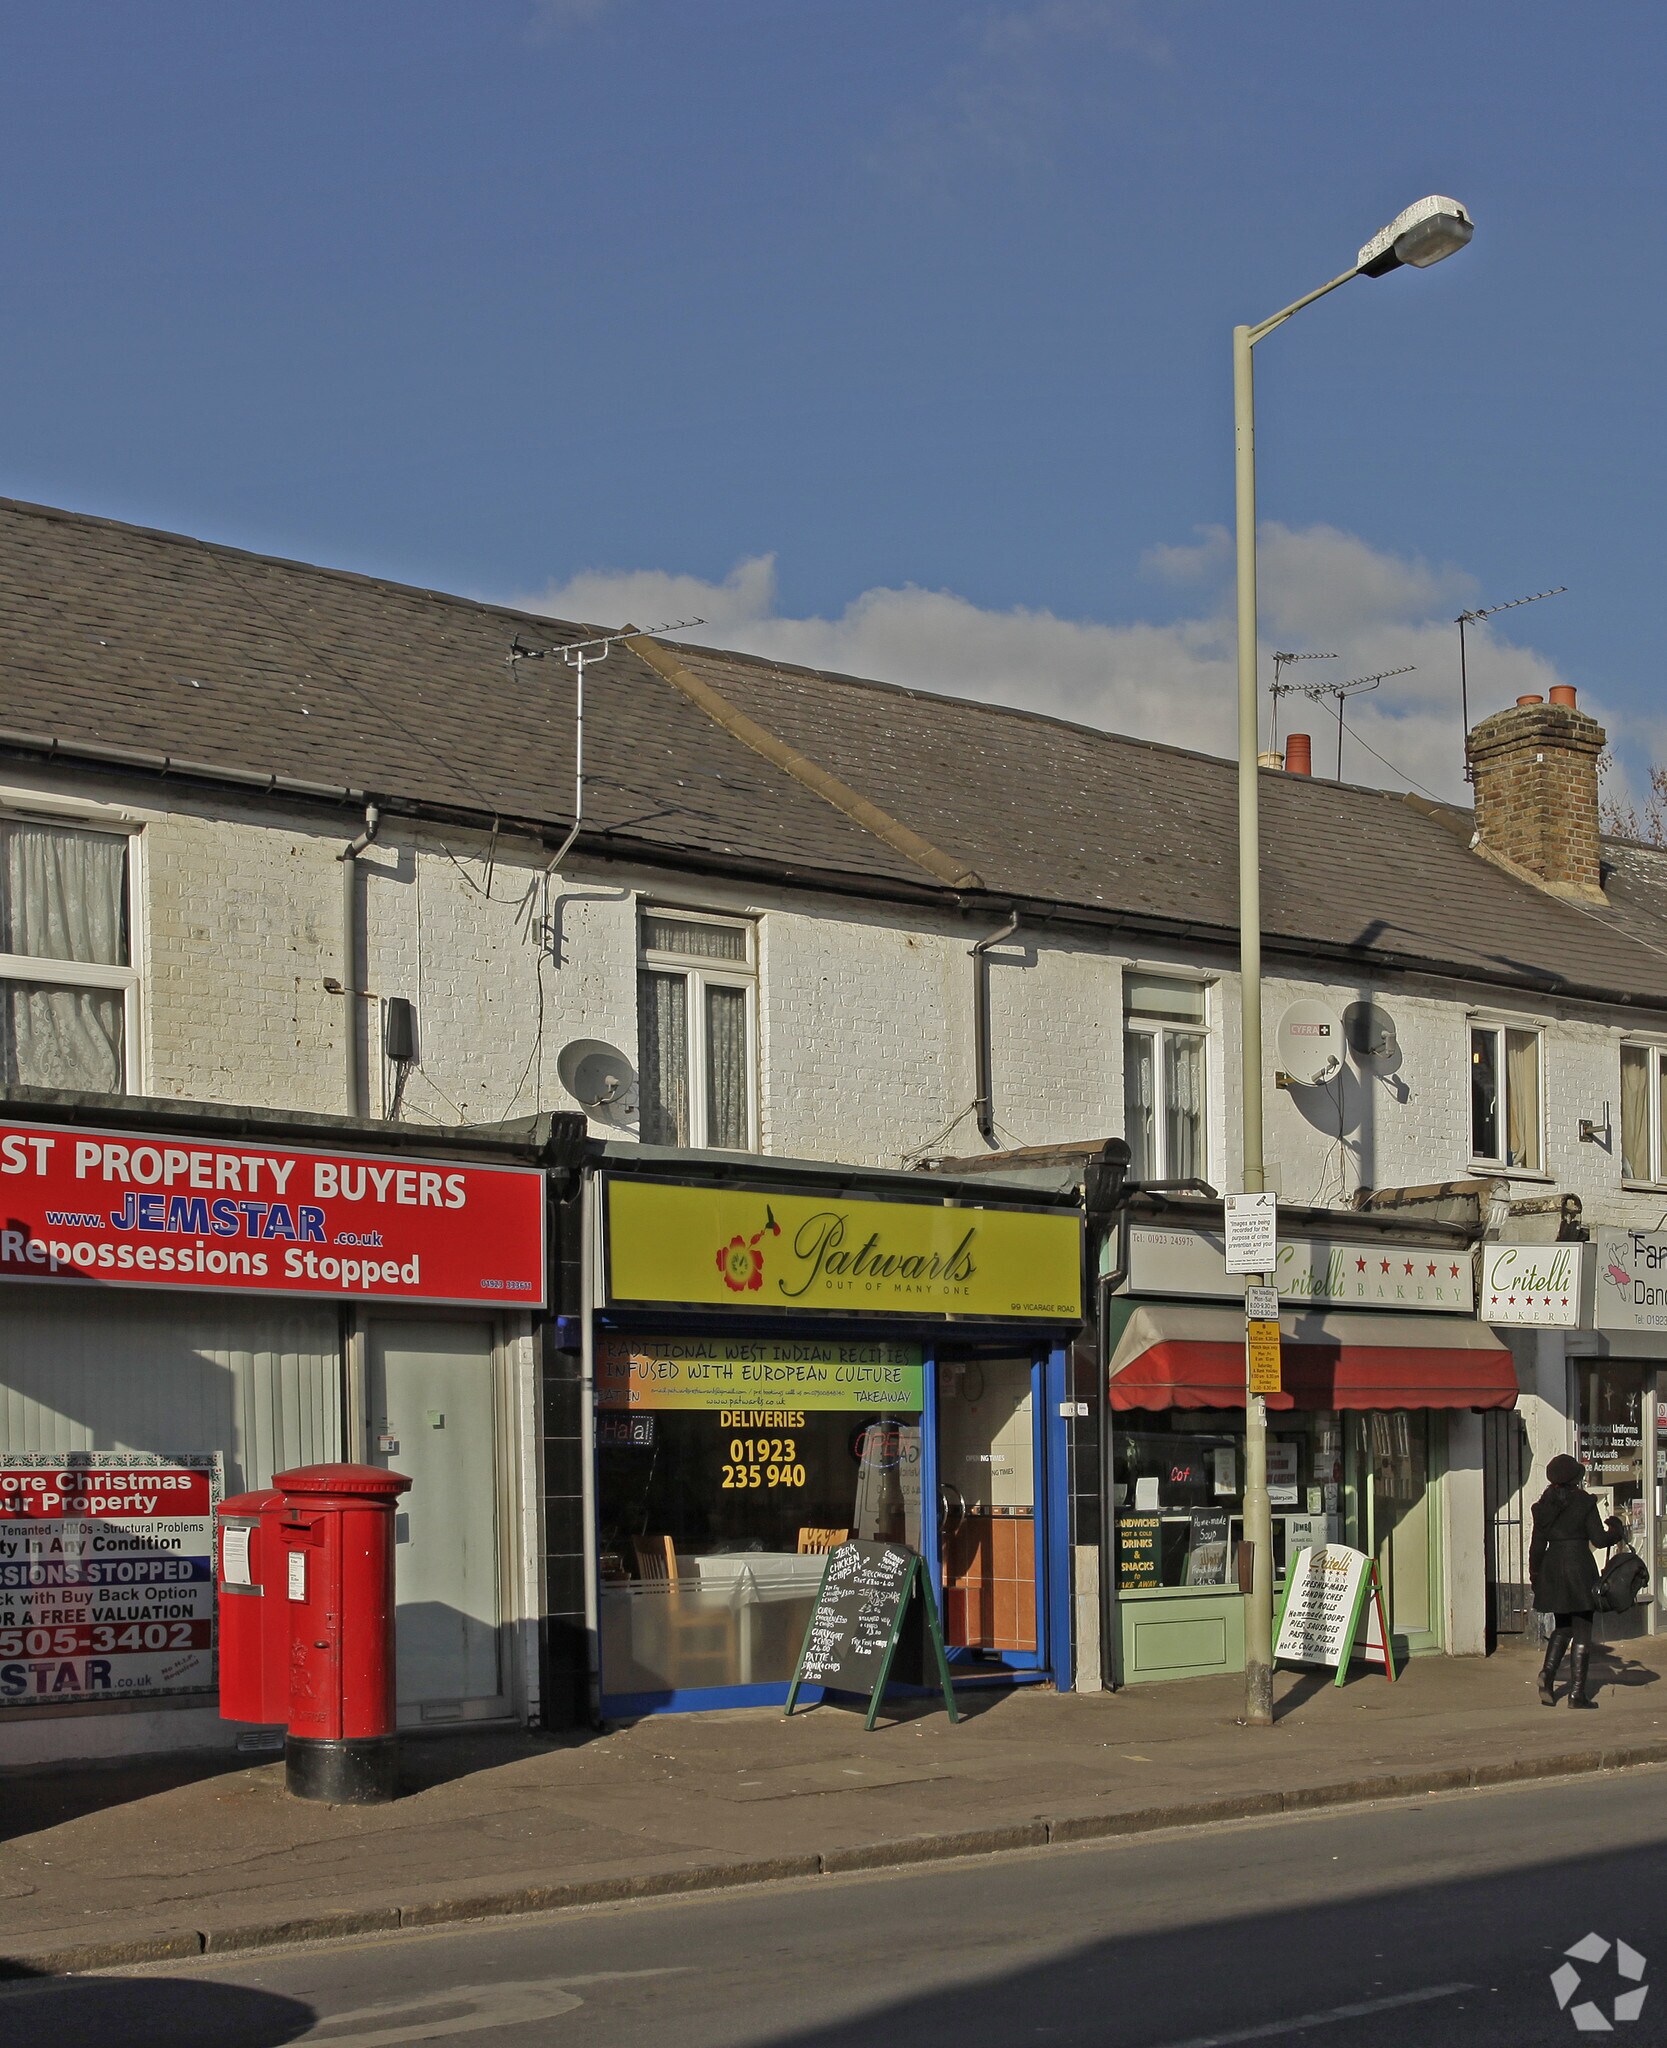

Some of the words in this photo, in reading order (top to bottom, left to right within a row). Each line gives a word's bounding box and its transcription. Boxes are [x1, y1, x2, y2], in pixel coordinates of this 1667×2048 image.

[1291, 1025, 1319, 1034] CYFRA
[1, 1134, 55, 1176] ST
[75, 1141, 296, 1195] PROPERTY
[314, 1162, 467, 1209] BUYERS
[110, 1191, 327, 1244] JEMSTAR
[1231, 1234, 1250, 1242] purpose
[1257, 1232, 1270, 1240] crime
[1232, 1226, 1253, 1234] recorded
[1132, 1232, 1144, 1243] Tel:
[1147, 1234, 1168, 1245] 01923
[1170, 1236, 1194, 1247] 245975
[1228, 1241, 1252, 1250] prevention
[1, 1229, 269, 1277] Repossessions
[284, 1247, 420, 1289] Stopped
[1271, 1245, 1346, 1298] Critelli
[1357, 1282, 1462, 1301] BAKERY
[1488, 1249, 1571, 1293] Critelli
[480, 1279, 504, 1289] 01923
[825, 1280, 853, 1290] OUT
[866, 1282, 882, 1291] OF
[894, 1284, 933, 1294] MANY
[943, 1286, 970, 1295] ONE
[1010, 1303, 1021, 1311] 99
[1023, 1303, 1055, 1313] VICARAGE
[1057, 1305, 1075, 1313] ROAD
[1488, 1310, 1571, 1322] BAKERY
[725, 1343, 767, 1362] WEST
[773, 1344, 832, 1362] INDIAN
[606, 1359, 680, 1382] INFUSED
[688, 1362, 734, 1380] WITH
[741, 1363, 828, 1383] EUROPEAN
[835, 1365, 902, 1384] CULTURE
[625, 1389, 640, 1402] IN
[853, 1390, 911, 1404] TAKEAWAY
[720, 1410, 806, 1428] DELIVERIES
[1612, 1423, 1639, 1434] Uniforms
[1611, 1437, 1625, 1447] Jazz
[1625, 1437, 1644, 1447] Shoes
[730, 1438, 796, 1463] 01923
[1592, 1449, 1618, 1459] Leotards
[1593, 1462, 1630, 1472] Accessories
[55, 1472, 192, 1491] Christmas
[721, 1465, 761, 1489] 235
[766, 1464, 806, 1488] 940
[42, 1492, 158, 1515] Property
[1, 1524, 52, 1536] Tenanted
[103, 1522, 154, 1534] Structural
[157, 1521, 204, 1533] Problems
[1115, 1518, 1160, 1529] SANDWICHES
[1293, 1521, 1312, 1534] JUMBO
[1200, 1528, 1217, 1542] Soup
[25, 1538, 43, 1554] In
[50, 1537, 87, 1556] Any
[92, 1535, 182, 1552] Condition
[1122, 1539, 1153, 1549] DRINKS
[833, 1543, 856, 1560] JERK
[1133, 1550, 1141, 1559] &
[830, 1552, 860, 1574] CHICKEN
[1121, 1561, 1154, 1572] SNACKS
[1309, 1549, 1353, 1572] Critelli
[86, 1560, 193, 1584] STOPPED
[1137, 1580, 1158, 1588] AWAY
[1301, 1579, 1349, 1593] FRESHLY-MADE
[20, 1591, 56, 1605] with
[62, 1590, 94, 1606] Buy
[99, 1588, 140, 1602] Back
[145, 1586, 198, 1602] Option
[1301, 1589, 1344, 1602] SANDWICHES
[1302, 1600, 1316, 1609] and
[1318, 1601, 1338, 1612] ROLLS
[21, 1611, 34, 1626] A
[41, 1608, 86, 1625] FREE
[92, 1604, 194, 1622] VALUATION
[1288, 1610, 1322, 1620] Homemade
[1322, 1612, 1346, 1623] SOUPS
[1306, 1622, 1341, 1634] SAUSAGES
[1316, 1633, 1337, 1643] PIZZA
[1278, 1641, 1291, 1650] Hot
[1298, 1642, 1313, 1652] Cold
[1313, 1645, 1340, 1656] DRINKS
[0, 1659, 112, 1697] STAR
